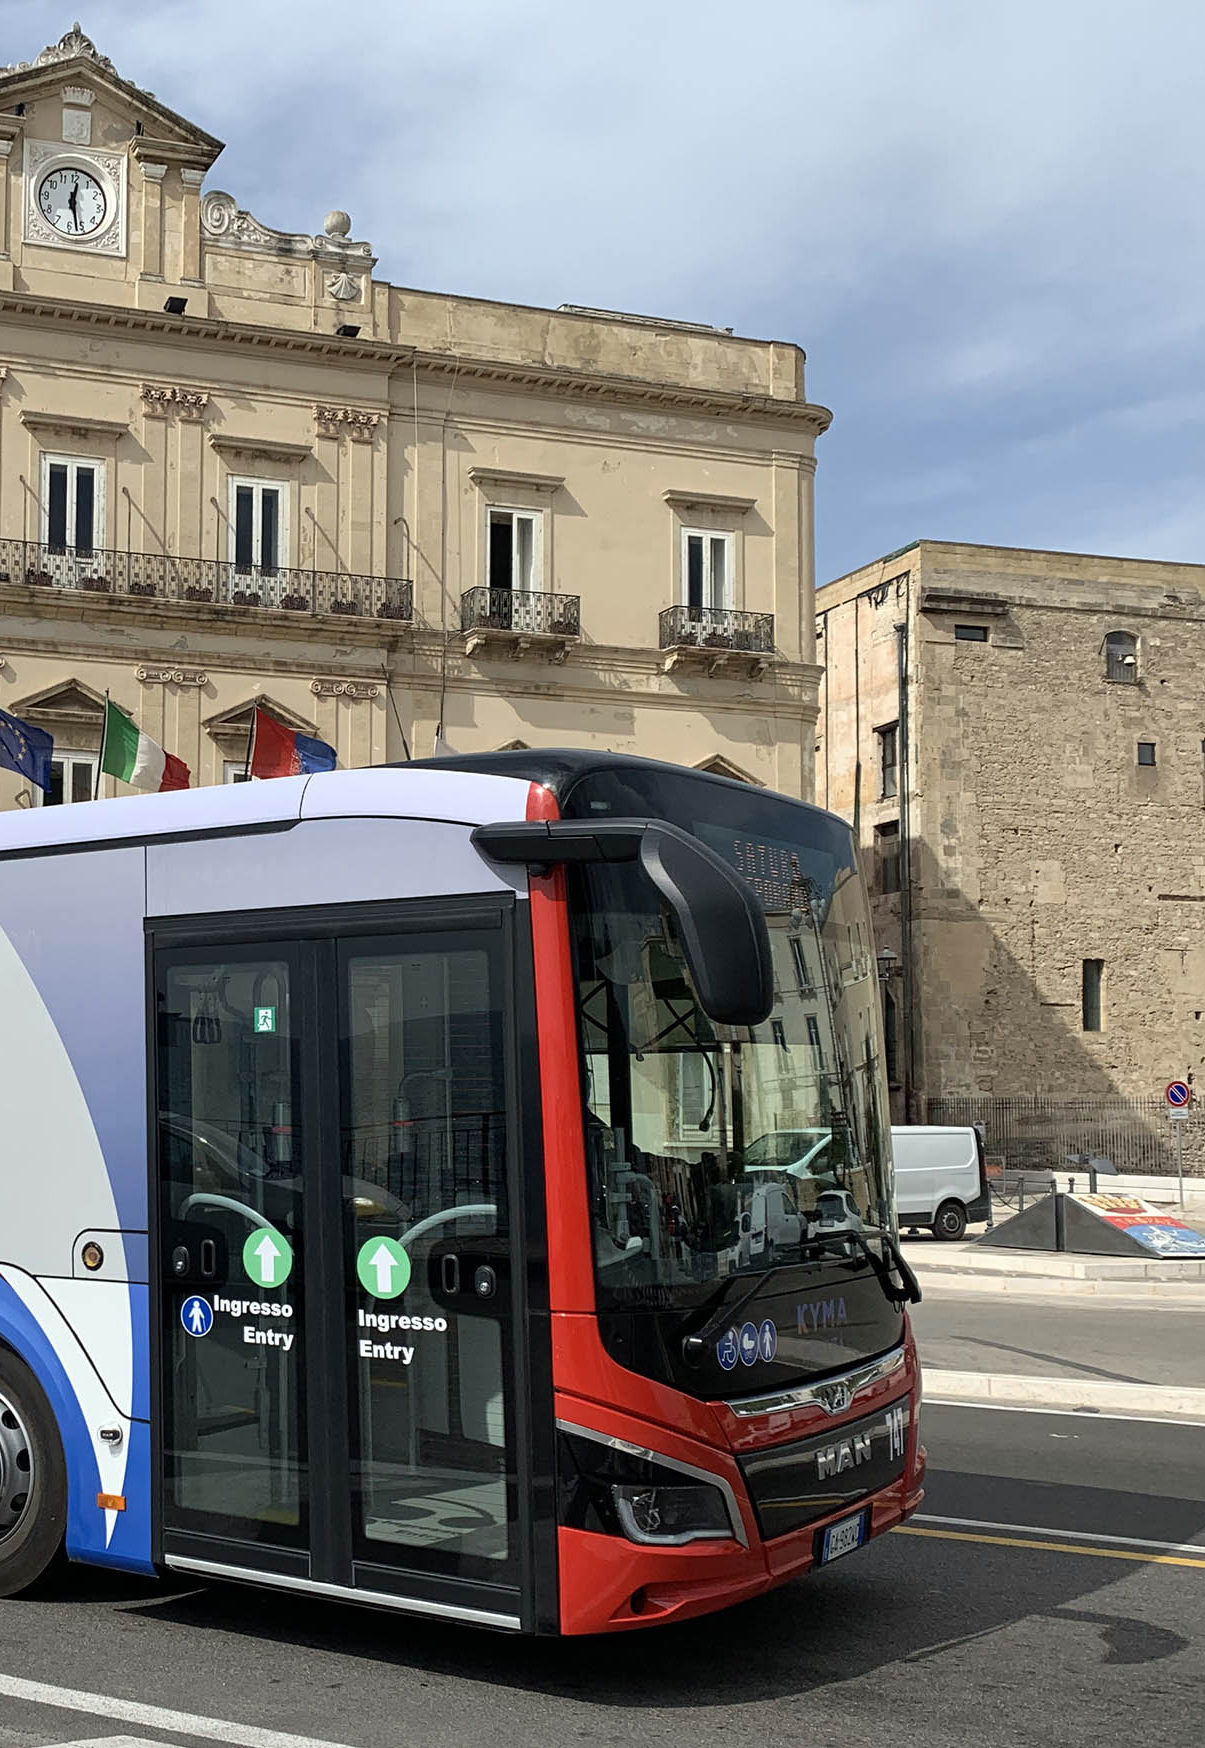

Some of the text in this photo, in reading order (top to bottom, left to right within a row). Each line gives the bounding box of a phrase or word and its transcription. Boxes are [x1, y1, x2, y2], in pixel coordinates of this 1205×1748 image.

[60, 174, 67, 184] 11
[71, 174, 80, 183] 12
[49, 180, 57, 190] 10
[44, 190, 50, 200] 9
[92, 191, 98, 200] 2
[46, 204, 52, 213] 8
[95, 203, 101, 213] 3
[89, 216, 95, 224] 4
[67, 221, 72, 231] 6
[79, 220, 85, 231] 5
[213, 1294, 294, 1318] Ingresso
[358, 1309, 447, 1333] Ingresso
[797, 1297, 846, 1335] KYMA
[243, 1325, 294, 1352] Entry
[359, 1339, 415, 1366] Entry
[815, 1432, 872, 1481] MAN
